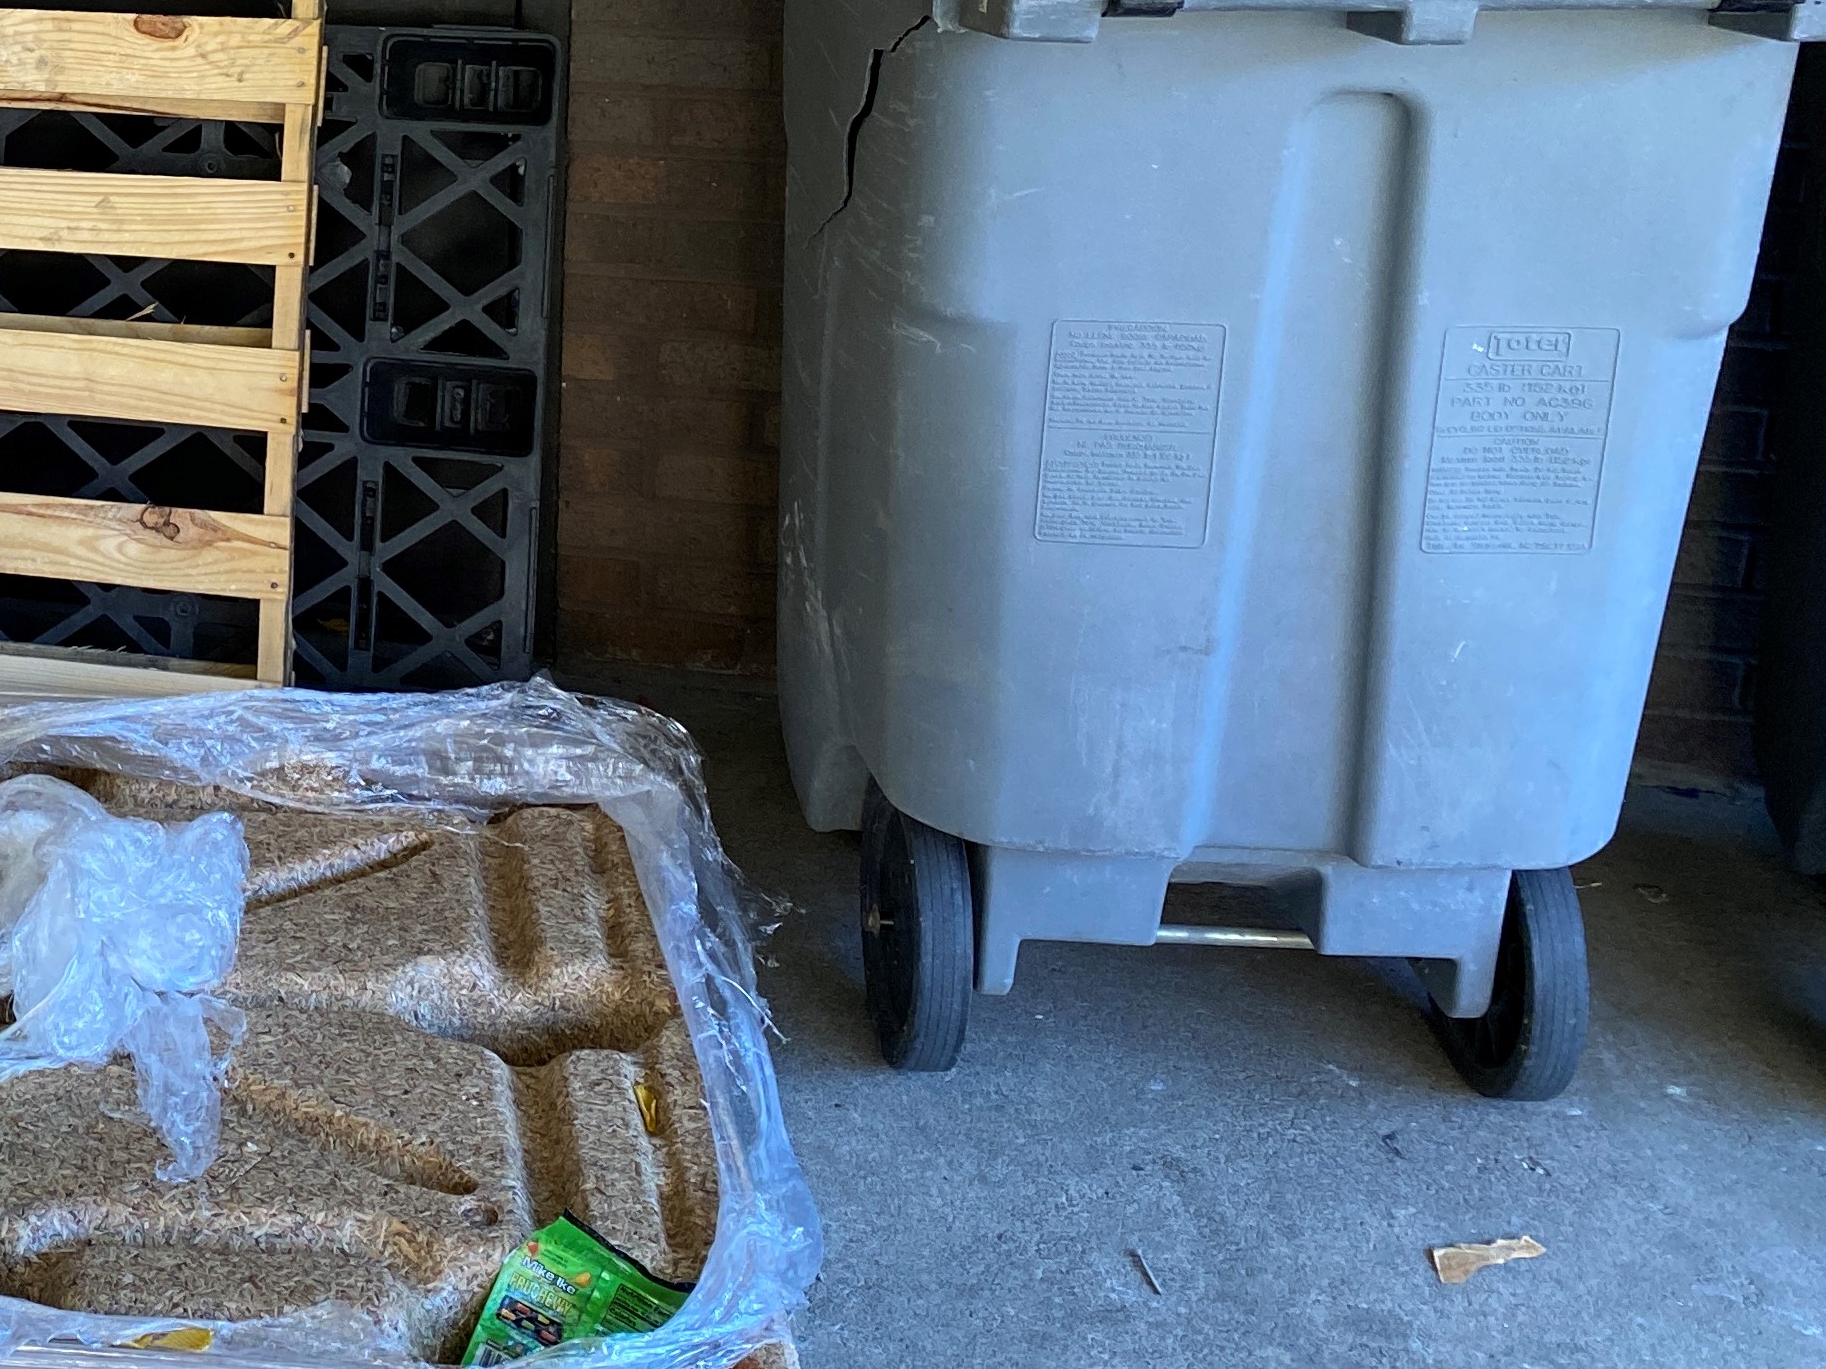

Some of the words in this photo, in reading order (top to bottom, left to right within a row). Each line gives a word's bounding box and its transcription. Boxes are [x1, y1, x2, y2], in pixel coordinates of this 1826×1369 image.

[1467, 363, 1532, 377] CASTER
[1540, 364, 1583, 378] CART
[1451, 396, 1491, 407] PART
[1503, 396, 1525, 407] NO
[1470, 411, 1509, 422] BODY
[1524, 411, 1569, 422] ONLY
[522, 1256, 555, 1281] Mike
[556, 1276, 576, 1294] Ike
